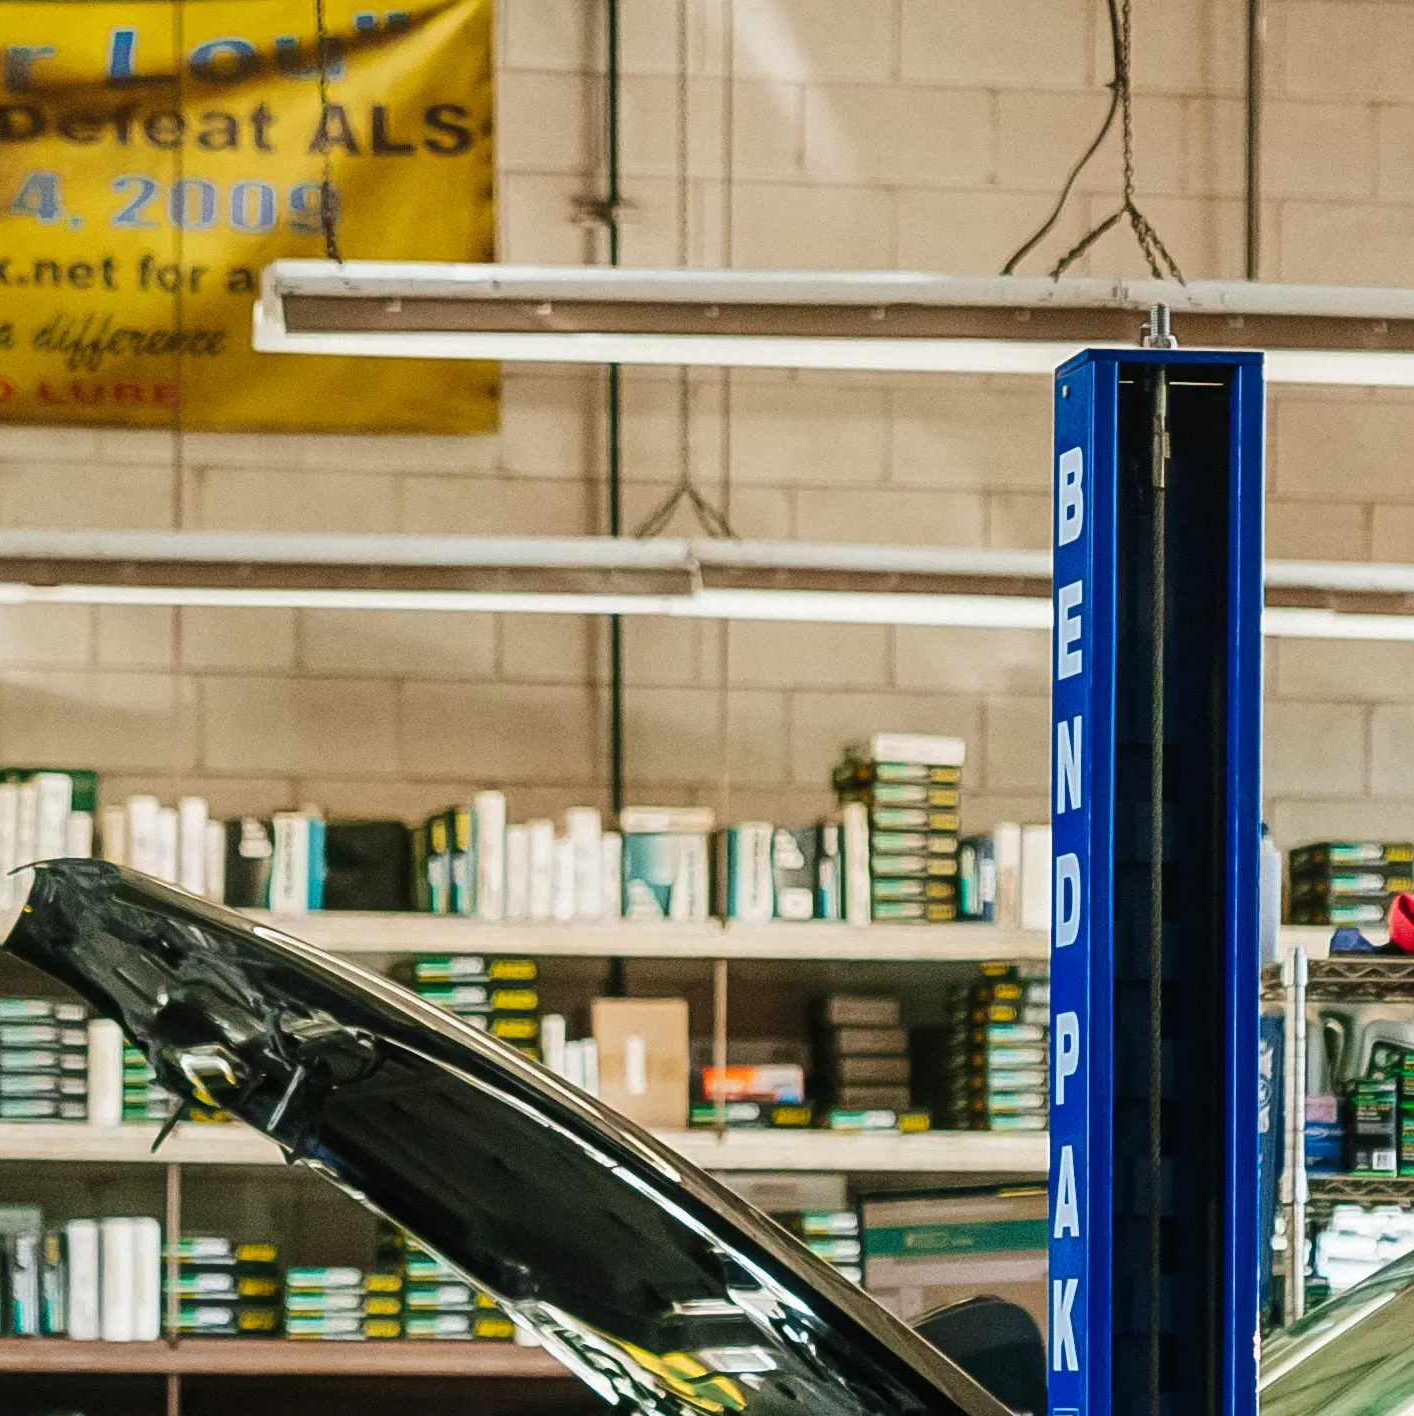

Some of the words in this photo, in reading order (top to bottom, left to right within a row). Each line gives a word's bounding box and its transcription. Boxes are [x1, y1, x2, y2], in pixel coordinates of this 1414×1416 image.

[307, 102, 476, 157] ALS
[10, 171, 85, 232] 4,
[108, 173, 342, 237] 2009
[136, 254, 212, 293] for
[30, 312, 228, 373] difference
[36, 380, 182, 404] LUBE
[1048, 446, 1084, 1374] BENDPAK
